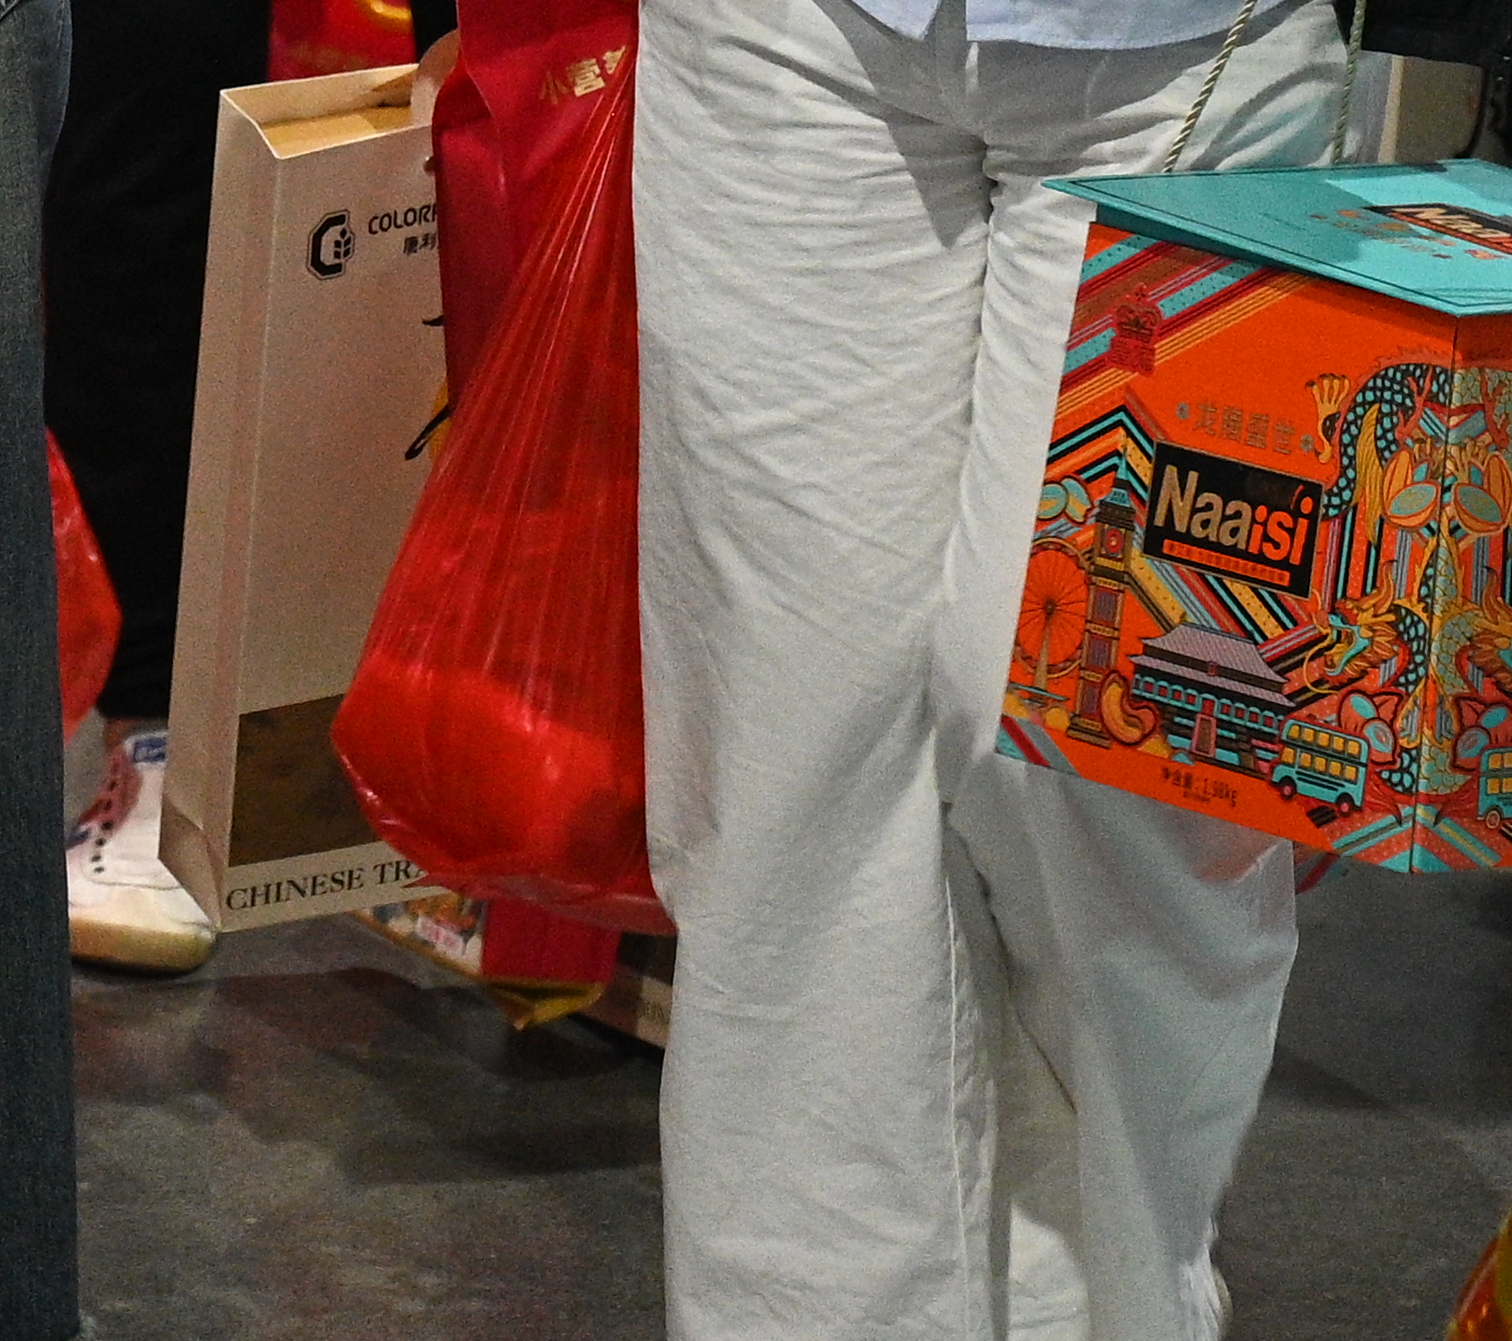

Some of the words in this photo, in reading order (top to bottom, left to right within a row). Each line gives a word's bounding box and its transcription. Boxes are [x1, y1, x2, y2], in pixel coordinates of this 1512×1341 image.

[368, 203, 437, 235] COLOR
[1192, 402, 1296, 455] 龙腾盛世
[1153, 464, 1314, 566] Naaisi
[226, 868, 365, 911] CHINESE
